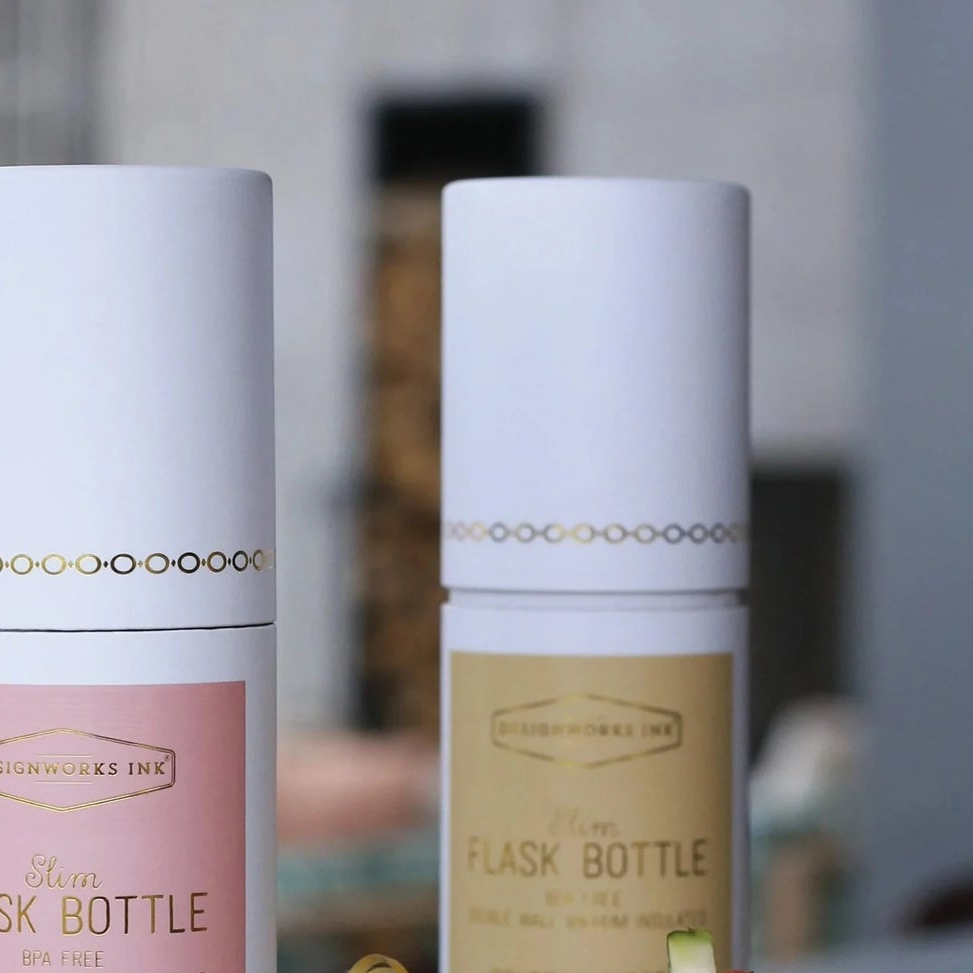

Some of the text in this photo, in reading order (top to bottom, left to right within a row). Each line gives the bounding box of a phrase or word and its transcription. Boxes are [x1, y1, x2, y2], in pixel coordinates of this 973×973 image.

[25, 854, 103, 890] Slim
[467, 836, 708, 879] FLASK BOTTLE
[61, 892, 209, 935] BOTTLE
[22, 949, 104, 968] BPA FREE
